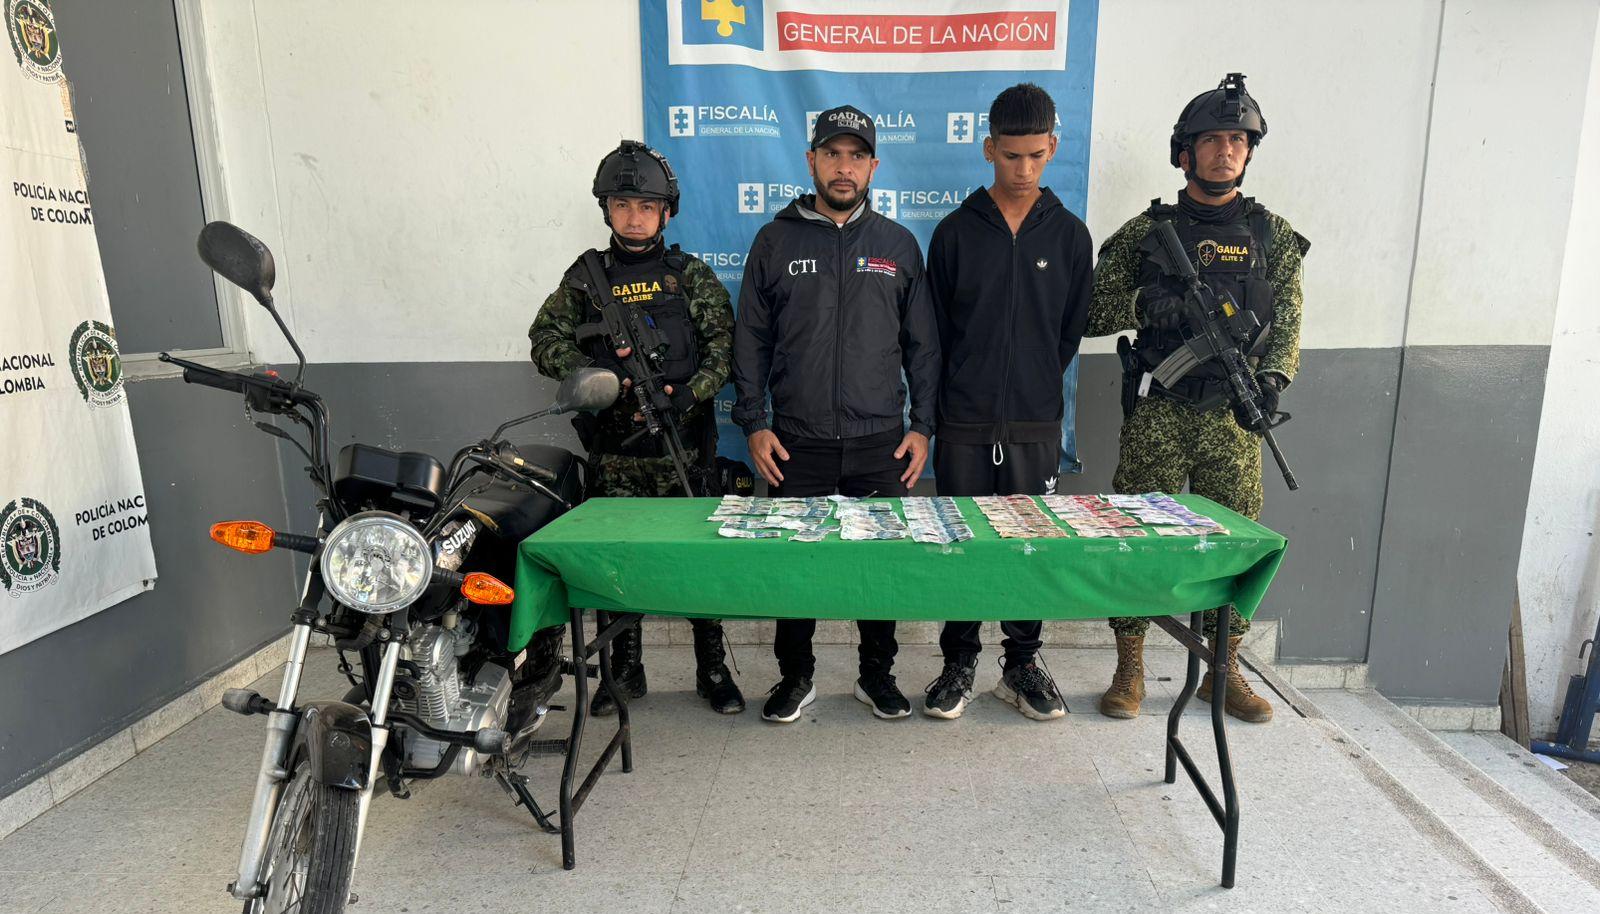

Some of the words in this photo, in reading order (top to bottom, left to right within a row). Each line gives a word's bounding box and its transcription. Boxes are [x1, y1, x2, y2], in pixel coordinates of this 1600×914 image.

[784, 22, 887, 44] GENERAL
[893, 26, 923, 44] DE
[930, 26, 956, 44] LA
[962, 16, 1049, 44] NACIÓN
[698, 105, 779, 123] FISCALÍA
[828, 111, 868, 128] GAULA
[874, 110, 916, 128] ALÍA
[700, 127, 733, 135] GENERAL
[754, 126, 779, 136] NACIÓN
[13, 182, 57, 201] POLICÍA
[59, 188, 89, 205] NACI
[900, 187, 970, 204] FISCALÍ
[31, 206, 45, 221] DE
[47, 208, 92, 225] COLOM
[1216, 245, 1249, 255] GAULA
[788, 259, 817, 276] CTI
[611, 281, 662, 296] GAULA
[622, 293, 653, 303] CARIBE
[0, 353, 55, 371] ACIONAL
[75, 501, 116, 526] POLICÍA
[117, 495, 145, 513] NAC
[92, 526, 106, 541] DE
[108, 514, 148, 536] COLOM
[442, 520, 477, 555] SUZUKI
